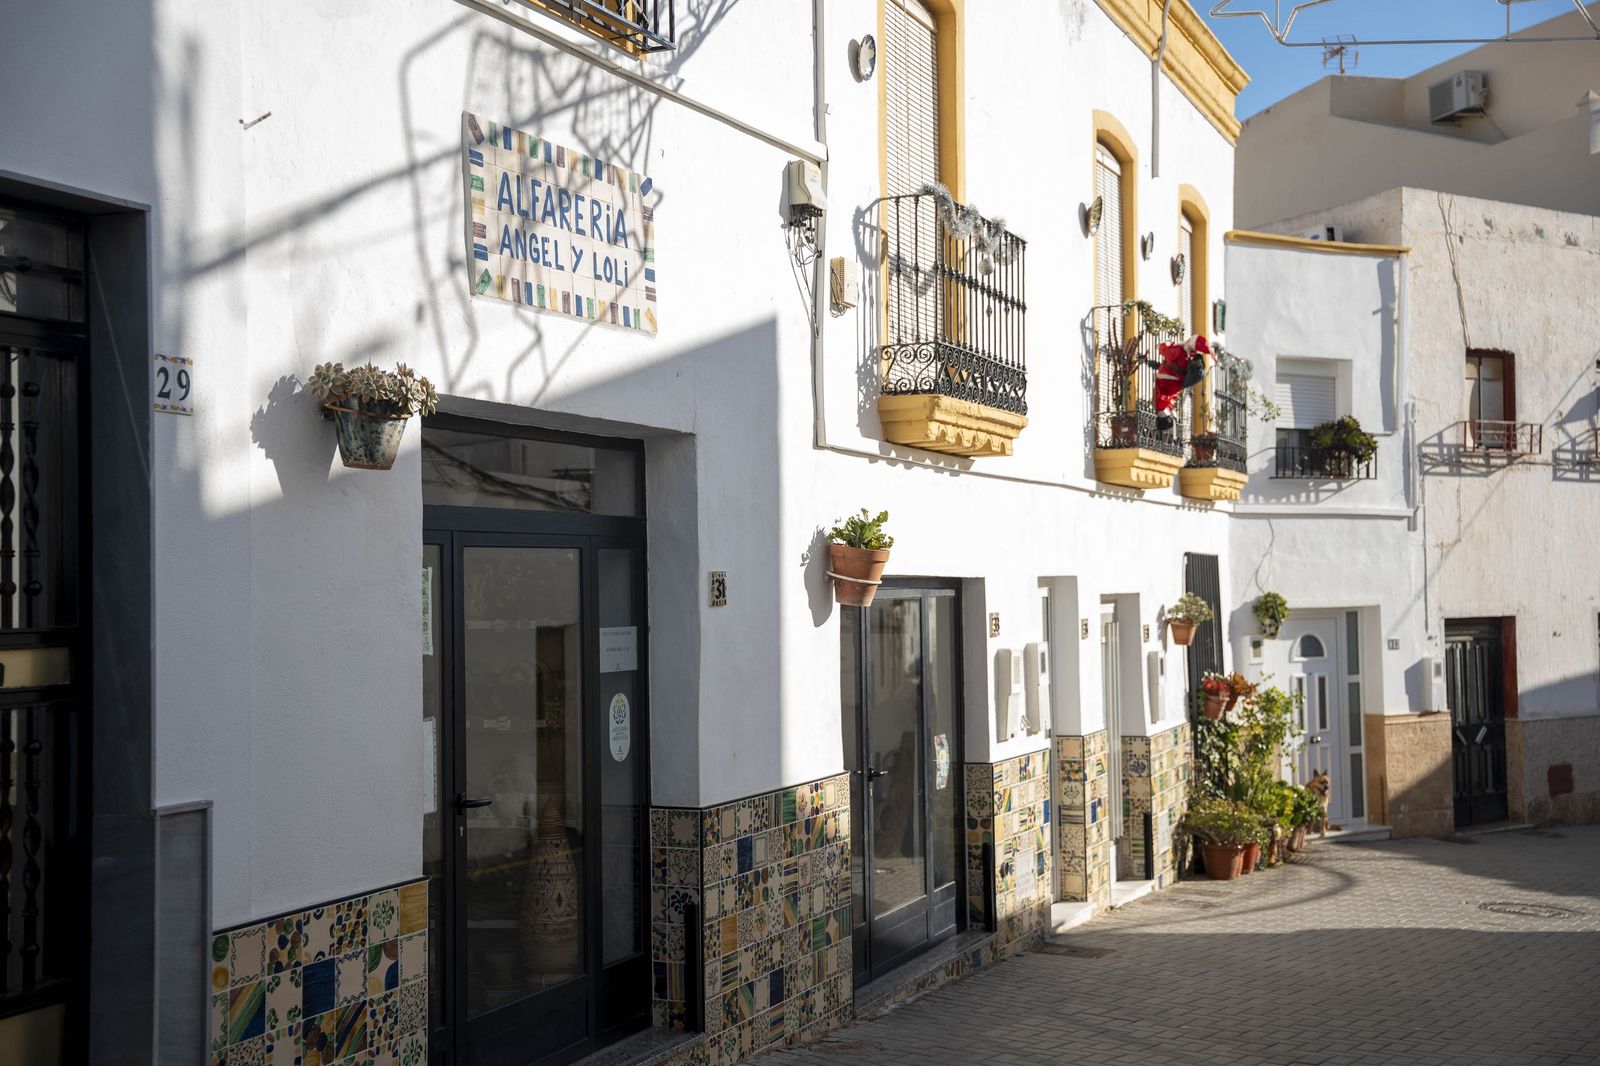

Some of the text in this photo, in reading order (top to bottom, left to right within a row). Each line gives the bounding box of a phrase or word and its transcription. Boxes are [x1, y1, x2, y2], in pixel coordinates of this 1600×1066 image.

[499, 223, 565, 272] ANGEL
[156, 366, 191, 401] 29
[715, 577, 726, 600] 31
